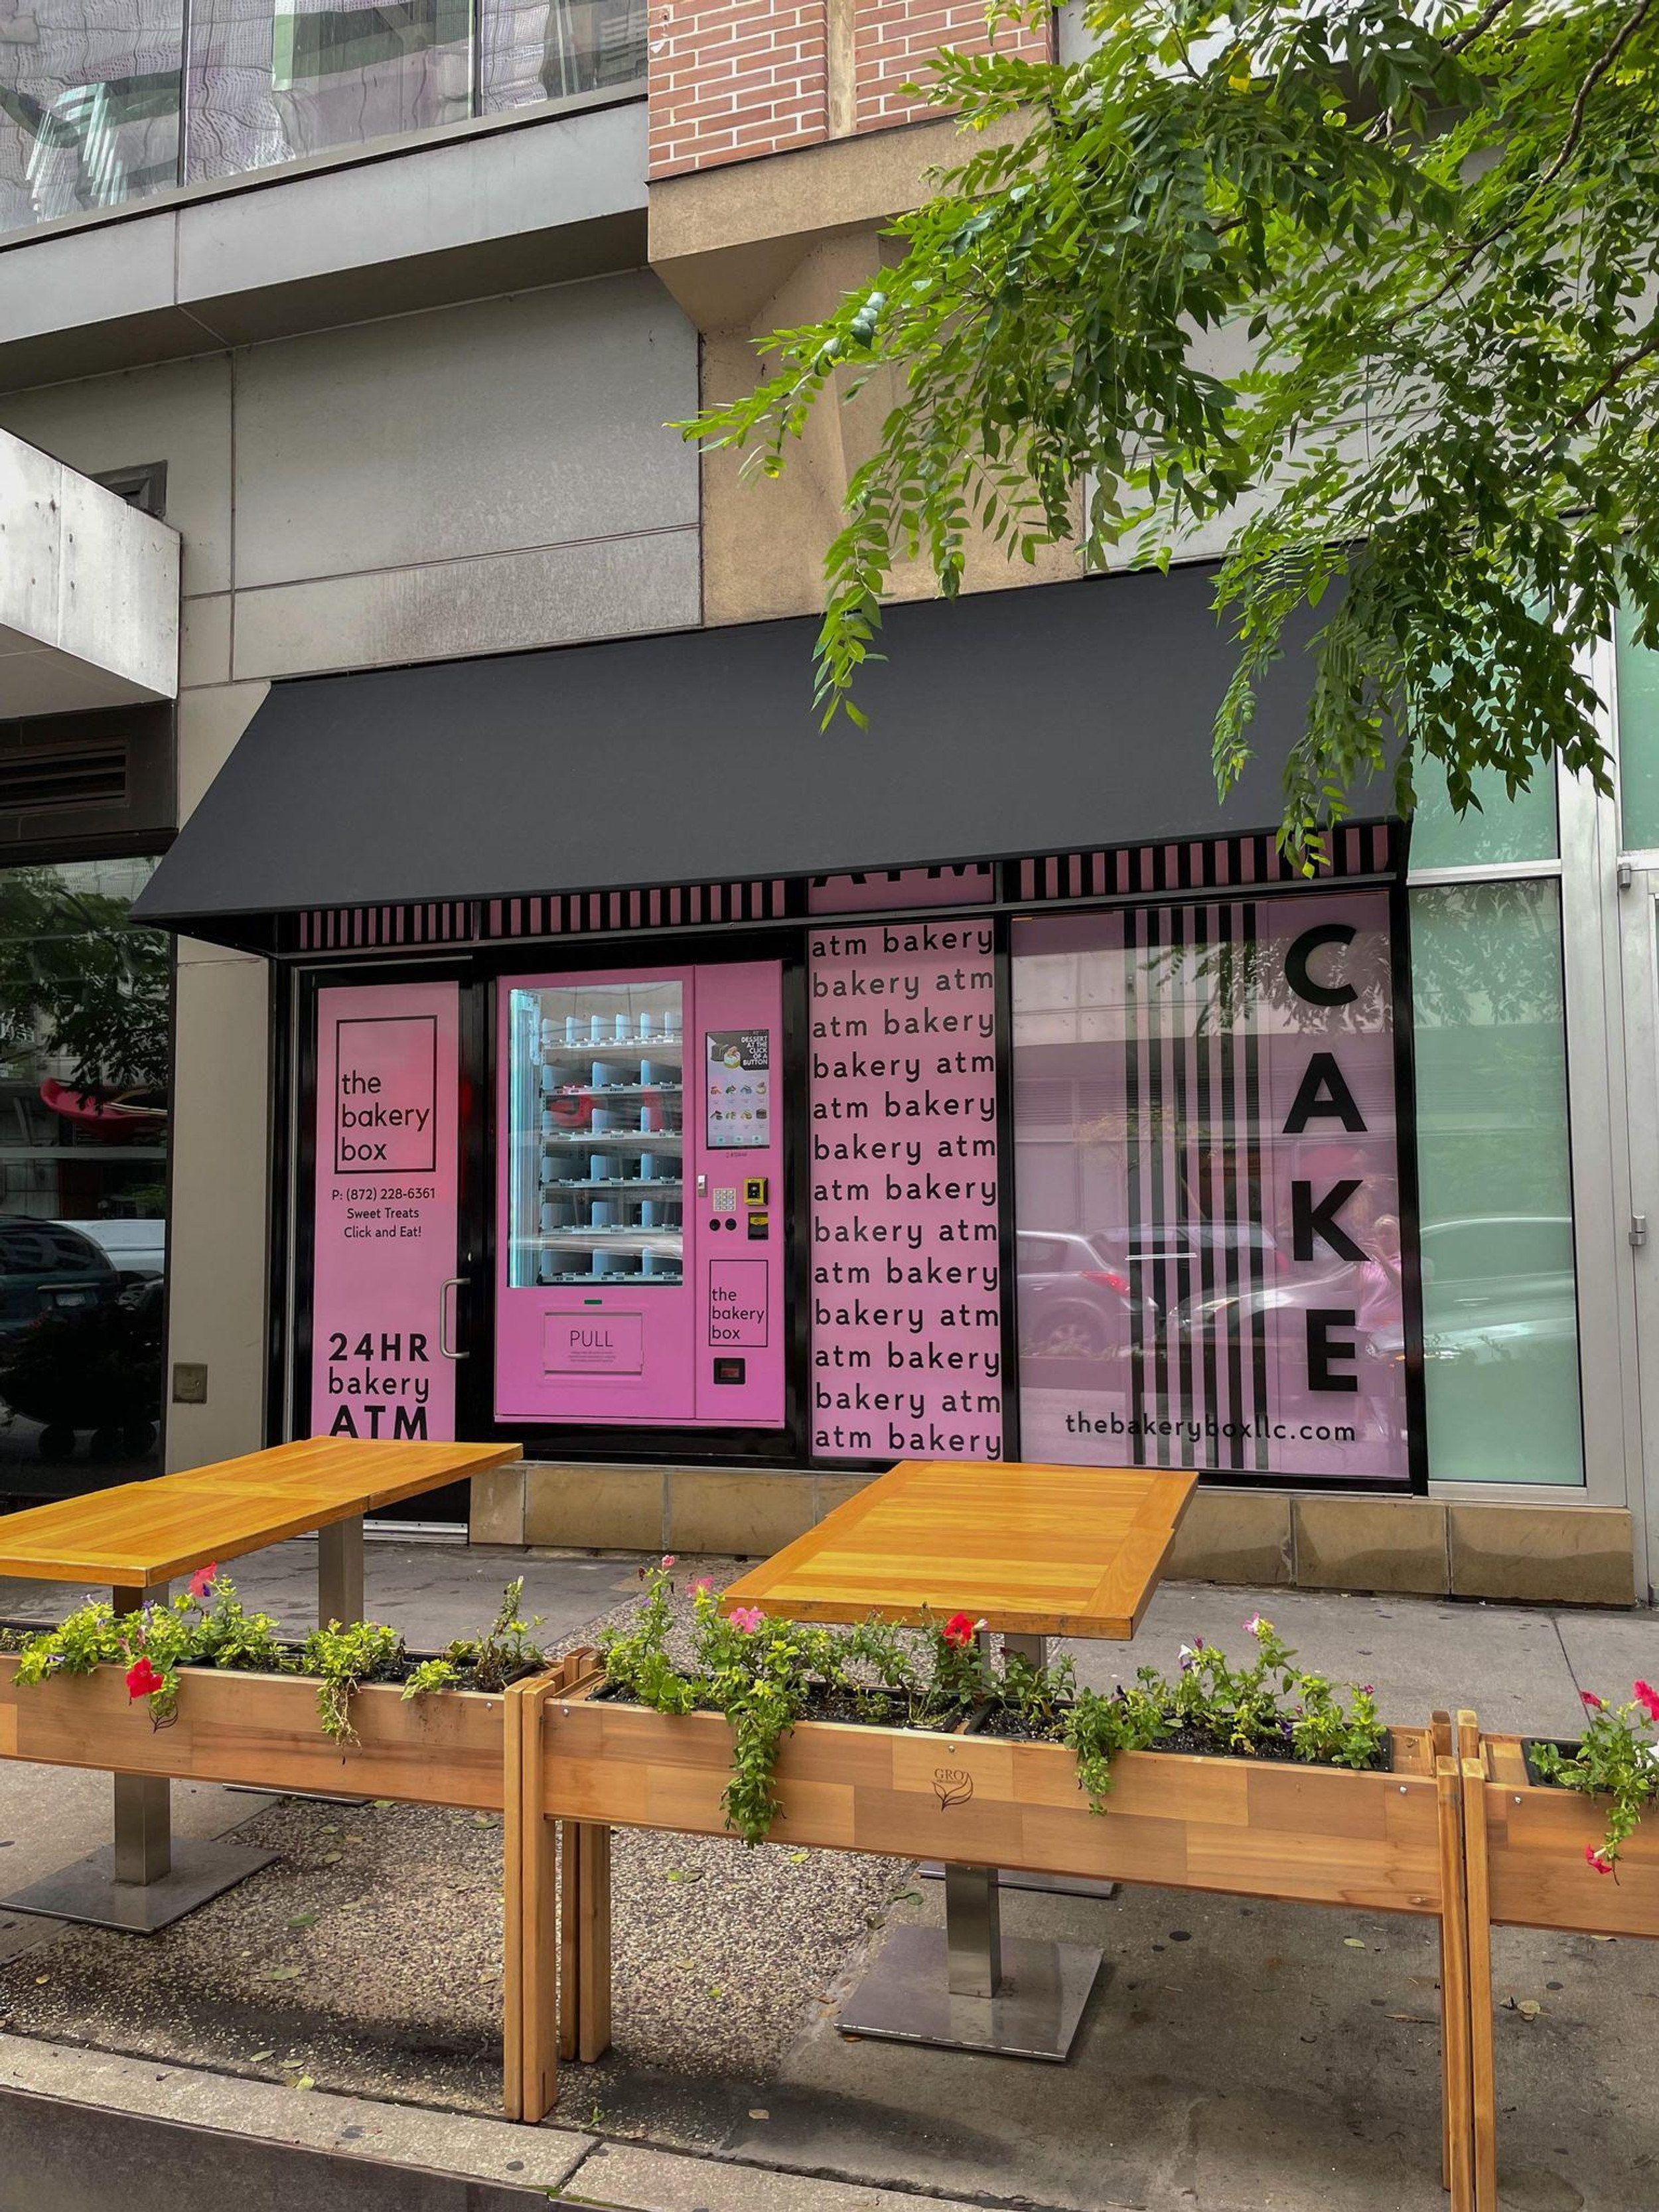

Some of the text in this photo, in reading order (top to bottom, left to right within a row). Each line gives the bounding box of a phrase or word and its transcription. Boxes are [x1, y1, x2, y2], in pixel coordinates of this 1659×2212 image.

[812, 925, 993, 957] atm bakery
[813, 969, 993, 999] bakery atm
[813, 1007, 994, 1038] atm bakery
[342, 1070, 381, 1094] the
[814, 1051, 994, 1082] bakery atm
[342, 1102, 429, 1132] bakery
[813, 1090, 995, 1122] atm bakery
[341, 1137, 387, 1161] box
[814, 1134, 995, 1165] bakery atm
[1282, 924, 1371, 1392] CAKE
[332, 1187, 435, 1201] P: (872) 228-6361
[814, 1173, 996, 1206] atm bakery
[347, 1208, 419, 1218] Sweet Treats
[344, 1226, 421, 1238] Click and Eat!
[815, 1217, 997, 1249] bakery atm
[814, 1257, 997, 1291] atm bakery
[712, 1287, 737, 1301] the
[712, 1306, 764, 1323] bakery
[816, 1299, 998, 1333] bakery atm
[328, 1333, 429, 1361] 24HR
[570, 1330, 613, 1347] PULL
[712, 1325, 740, 1339] box
[816, 1341, 999, 1377] atm bakery
[329, 1366, 429, 1404] bakery
[816, 1382, 1000, 1419] bakery atm
[329, 1405, 427, 1440] ATM
[1065, 1411, 1356, 1442] thebakeryboxllc.com
[816, 1422, 1001, 1460] atm bakery
